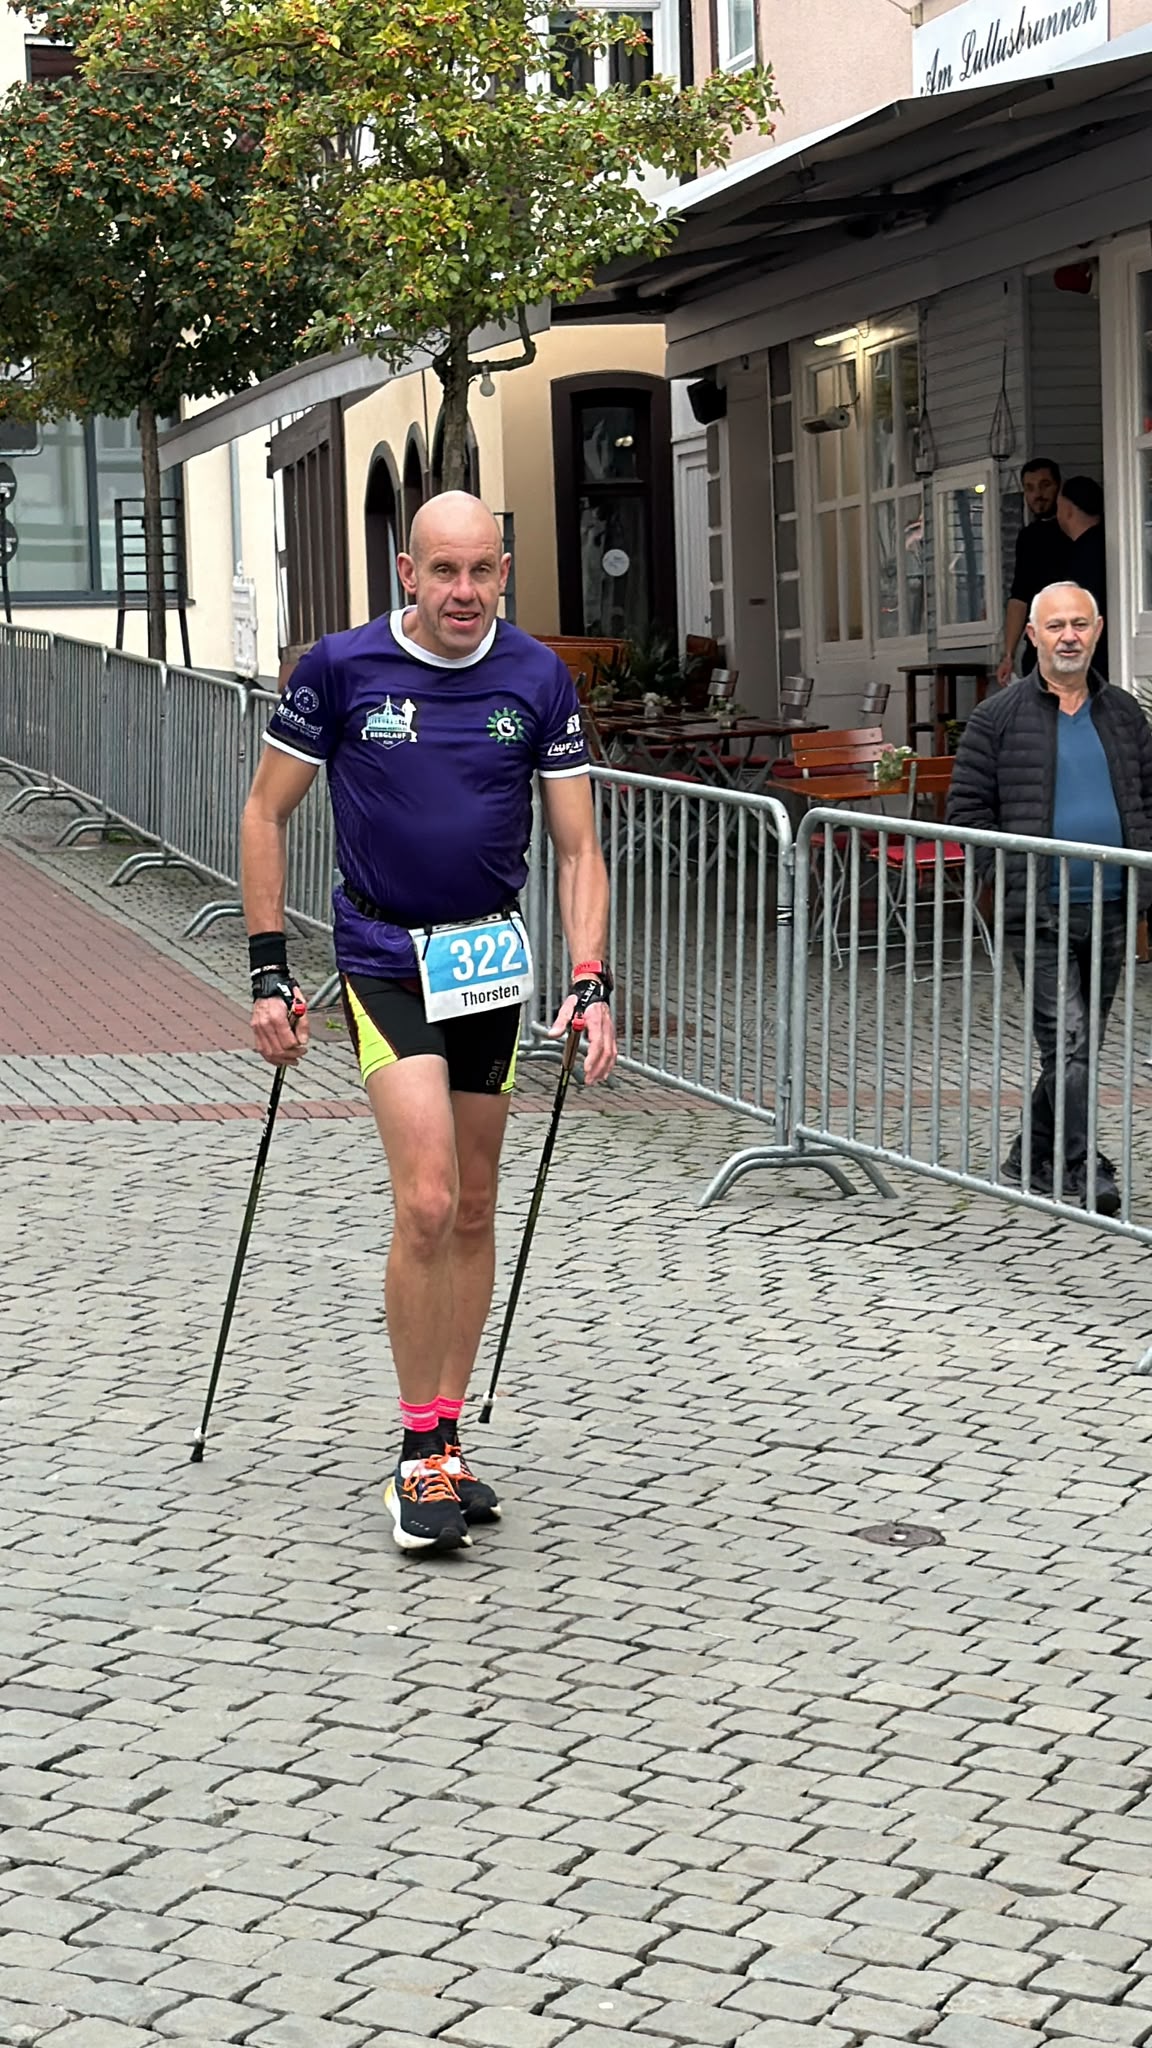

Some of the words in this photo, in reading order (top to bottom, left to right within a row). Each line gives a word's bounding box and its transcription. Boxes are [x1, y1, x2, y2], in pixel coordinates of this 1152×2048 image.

[920, 48, 953, 96] Am
[959, 0, 1098, 82] Lullusbrunnen
[450, 930, 523, 982] 322
[461, 984, 520, 1007] Thorsten
